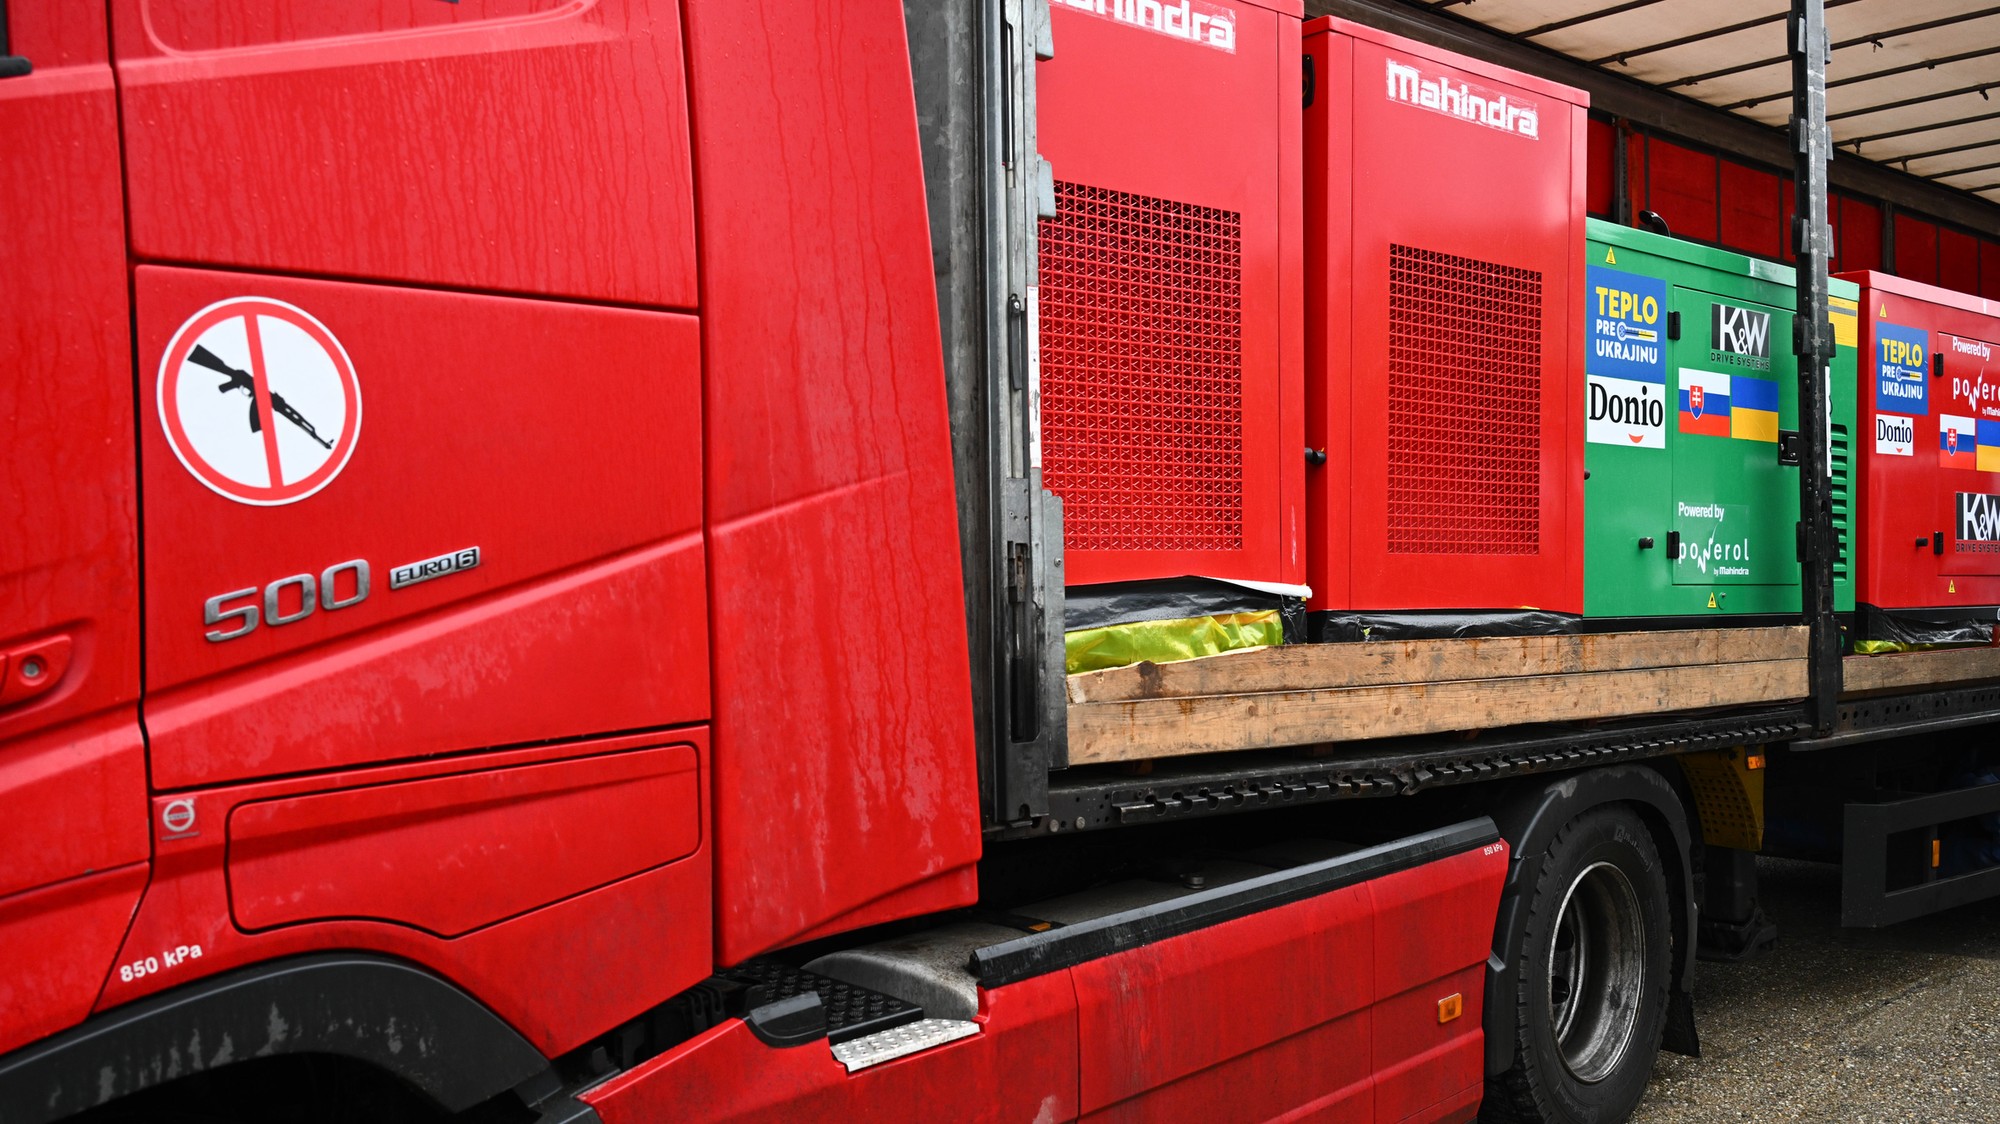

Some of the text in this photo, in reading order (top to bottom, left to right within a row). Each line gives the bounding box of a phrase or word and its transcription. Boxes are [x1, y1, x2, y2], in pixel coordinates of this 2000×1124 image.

[1050, 0, 1233, 49] indra
[1386, 60, 1539, 138] Mahindra
[1595, 286, 1658, 325] TEPLO
[1596, 318, 1616, 337] PRE
[1719, 304, 1770, 358] K&W
[1596, 338, 1658, 365] UKRAJINU
[1711, 352, 1771, 371] DRIVE SYSTEMS
[1881, 338, 1923, 368] TEPLO
[1952, 336, 1991, 362] Powered by
[1882, 364, 1896, 378] PRE
[1882, 381, 1923, 400] UKRAJINU
[1589, 382, 1664, 428] Donio
[1877, 418, 1912, 443] Donio
[1678, 501, 1725, 522] Powered by
[1679, 524, 1749, 574] powerol
[1956, 542, 1977, 553] DRIVE
[395, 556, 451, 584] EURO
[1713, 566, 1749, 576] by Mahindra
[205, 558, 371, 642] 500
[1483, 843, 1503, 856] 850 kPa
[120, 944, 203, 982] 850 kPa
